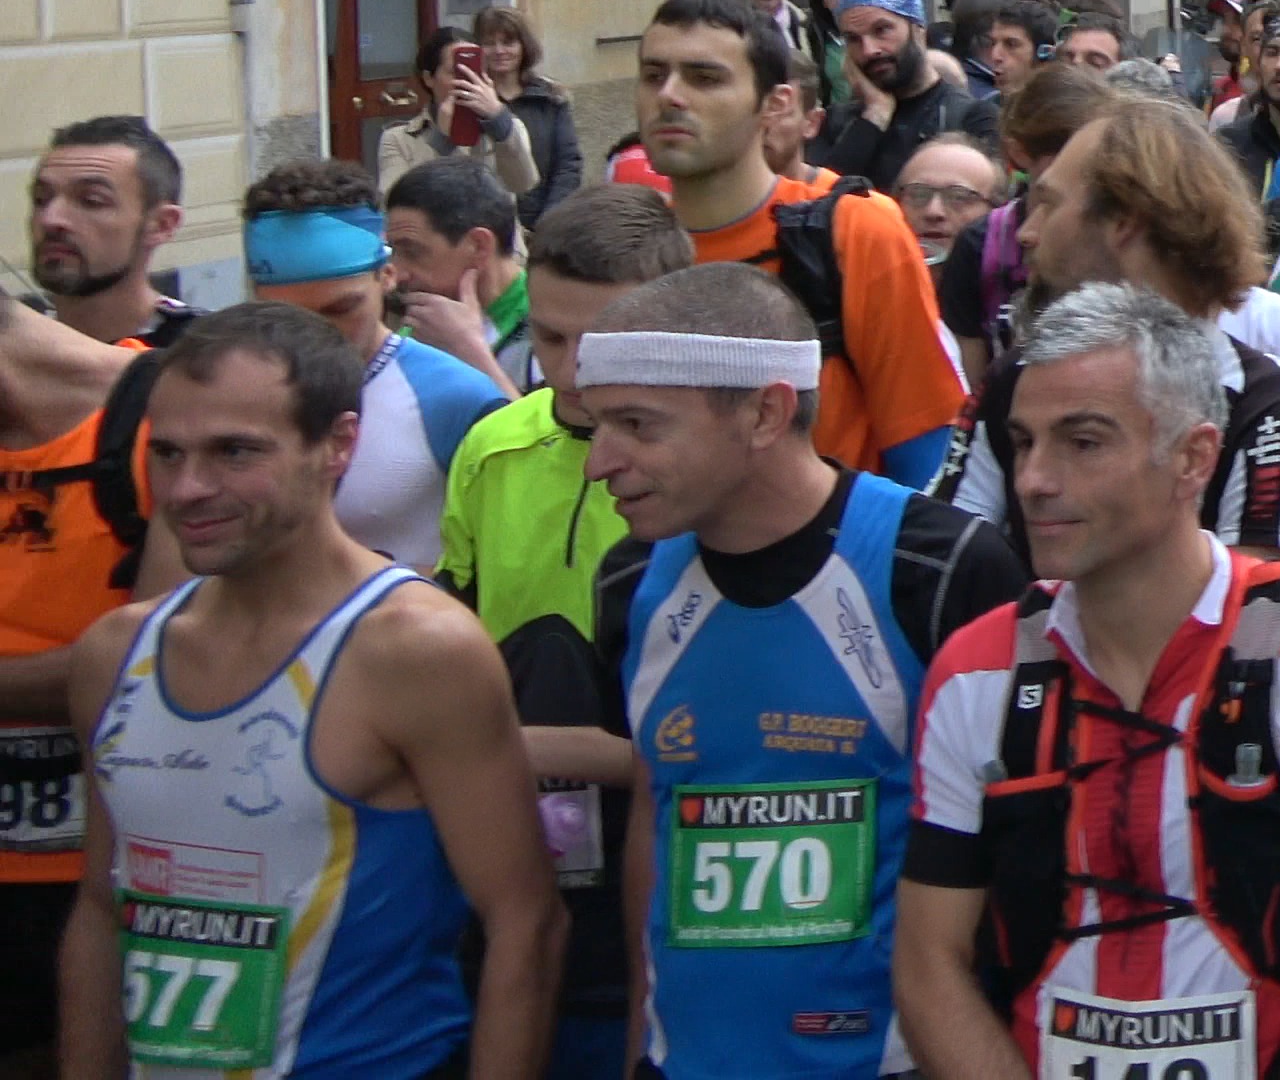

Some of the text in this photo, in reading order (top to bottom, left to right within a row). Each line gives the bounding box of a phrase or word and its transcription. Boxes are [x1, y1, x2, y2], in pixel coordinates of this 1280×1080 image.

[703, 791, 861, 825] MYRUN.IT
[692, 837, 832, 913] 570
[131, 904, 277, 946] MYRUN.IT
[123, 950, 241, 1032] 577
[1075, 1007, 1238, 1046] MYRUN.IT
